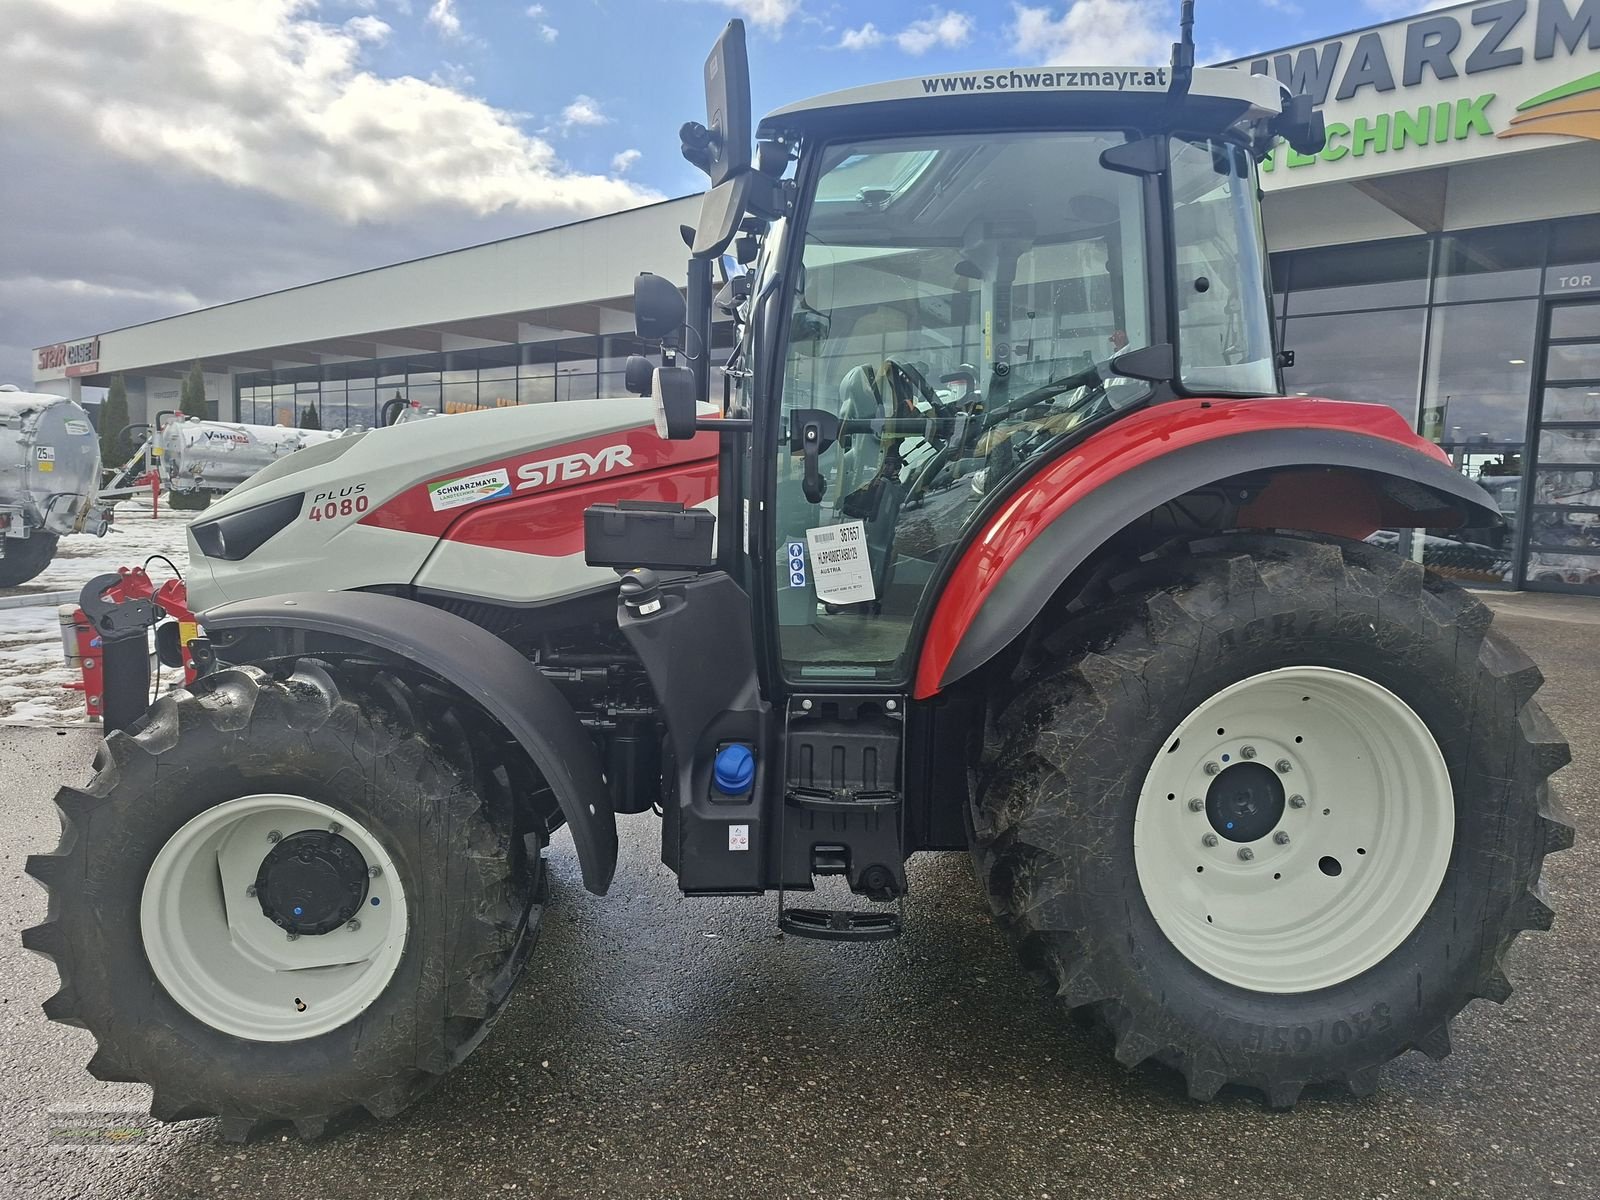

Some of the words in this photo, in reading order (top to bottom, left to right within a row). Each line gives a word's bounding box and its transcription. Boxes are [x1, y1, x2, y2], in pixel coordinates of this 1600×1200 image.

[1250, 0, 1600, 106] WARZM
[921, 67, 1167, 93] www.schwarzmayr.at
[1559, 275, 1593, 288] TOR
[37, 447, 48, 459] 25
[516, 444, 635, 491] STEYR
[314, 483, 367, 503] PLUS
[437, 477, 498, 496] SCHWARZMAYR
[308, 495, 370, 523] 4080
[820, 567, 842, 575] AUSTRIA
